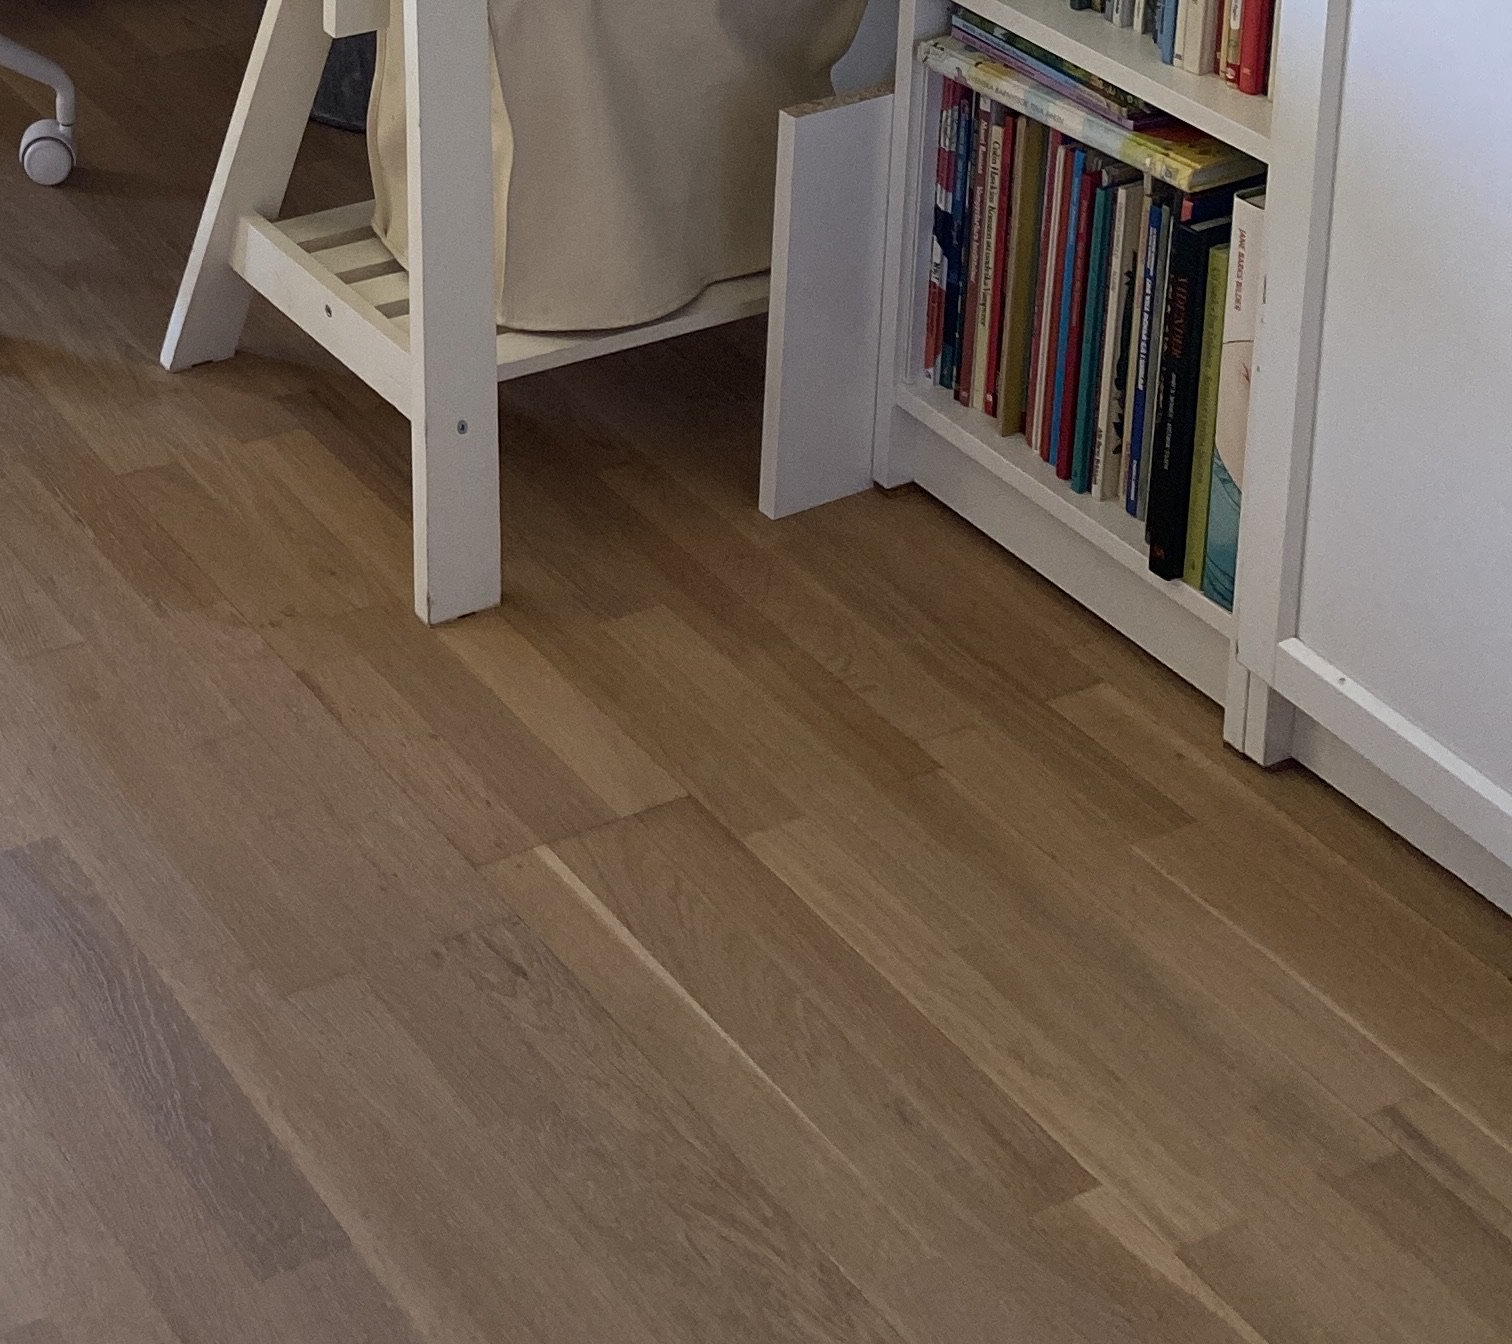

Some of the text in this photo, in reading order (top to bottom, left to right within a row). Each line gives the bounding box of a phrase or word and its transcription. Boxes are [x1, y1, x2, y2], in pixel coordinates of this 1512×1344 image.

[978, 118, 987, 144] Mauri
[990, 140, 1000, 165] Colin
[987, 166, 998, 204] Hawkins
[1237, 228, 1247, 250] JANE
[1234, 281, 1243, 311] BILDER
